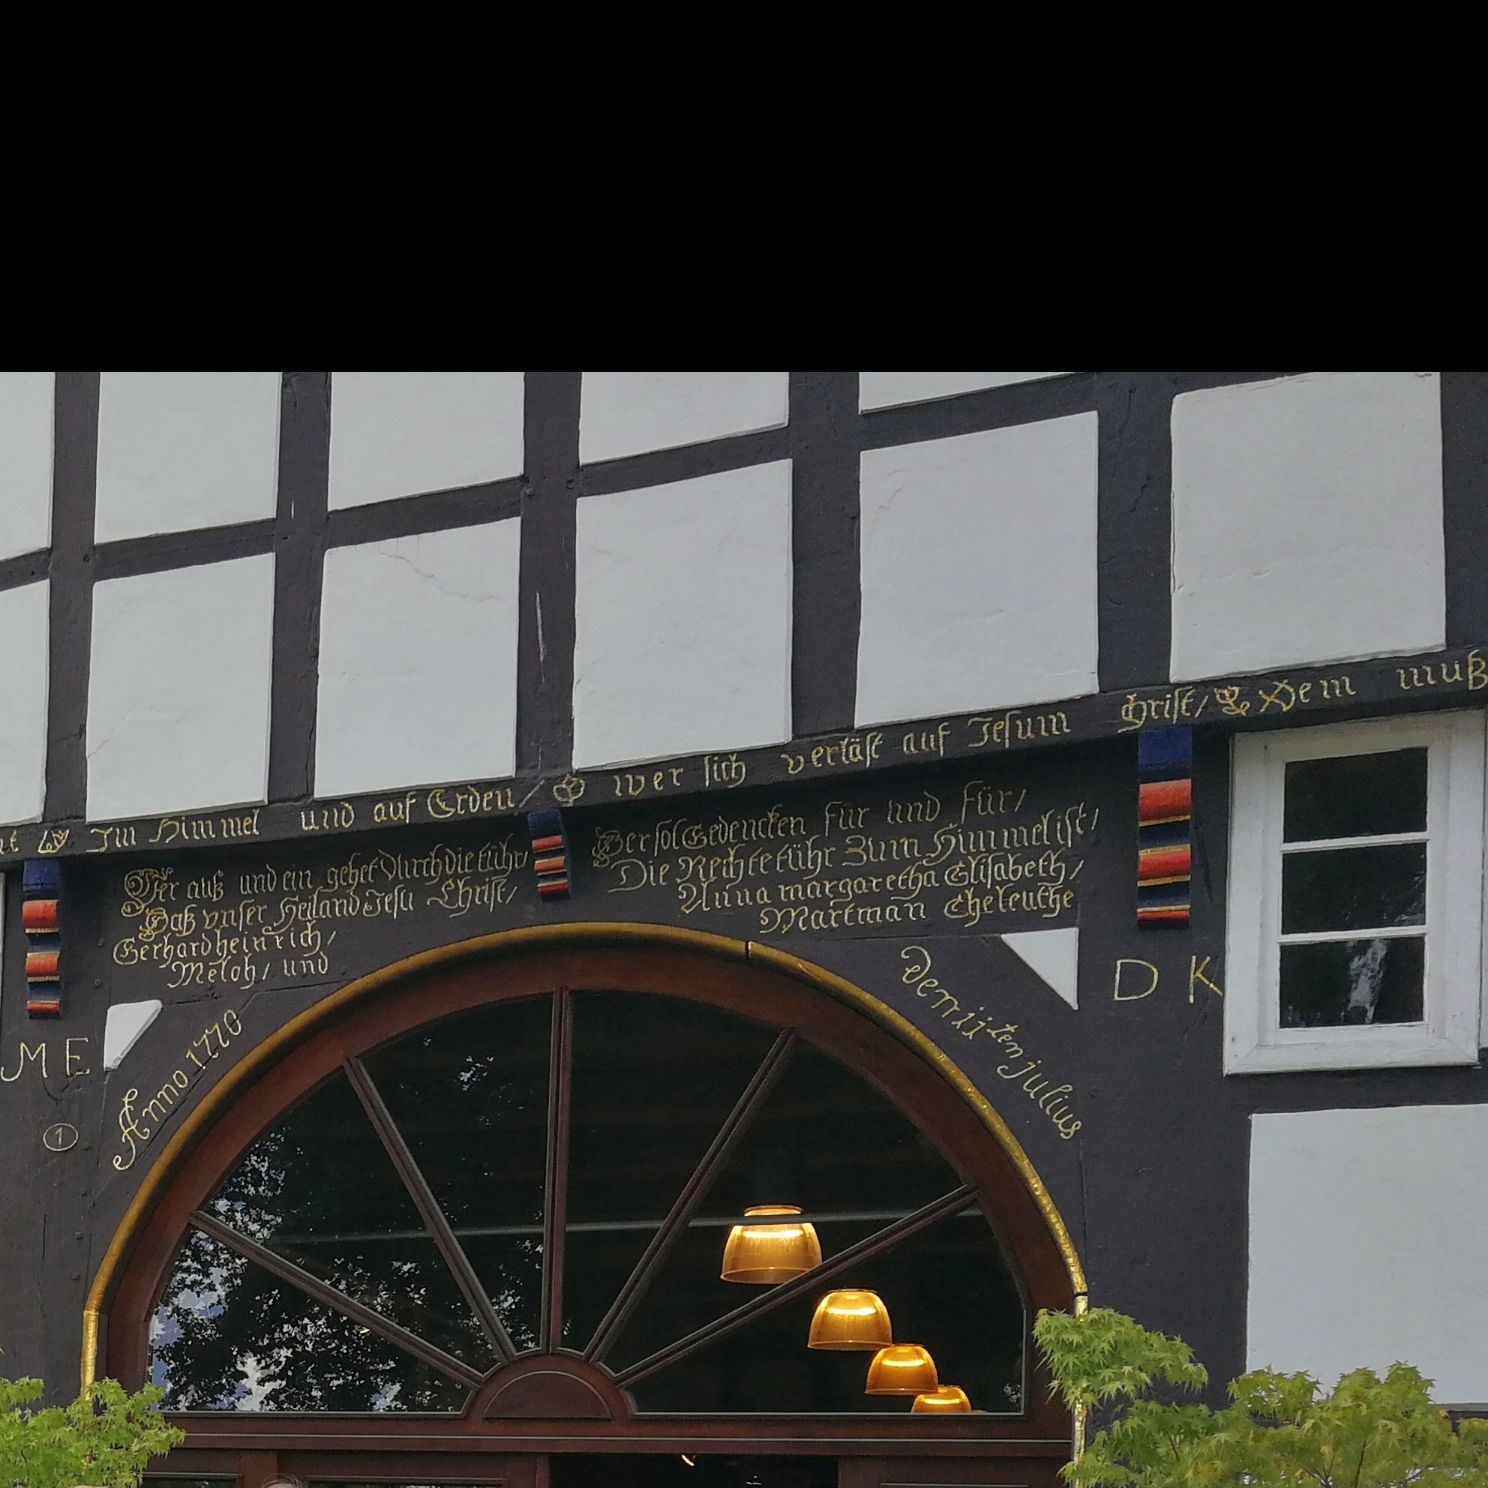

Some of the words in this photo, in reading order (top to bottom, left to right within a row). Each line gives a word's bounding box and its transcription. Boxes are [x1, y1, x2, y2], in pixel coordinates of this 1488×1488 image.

[149, 808, 260, 844] Himmel
[374, 791, 416, 824] auf
[903, 722, 950, 757] auf
[887, 791, 940, 825] und
[240, 864, 277, 895] und
[282, 865, 313, 891] ein
[608, 858, 670, 894] Die
[283, 952, 329, 977] und
[1114, 958, 1160, 1001] D
[1188, 955, 1224, 1004] K
[0, 1041, 48, 1082] M
[66, 1037, 91, 1075] E
[113, 1068, 190, 1171] Anno
